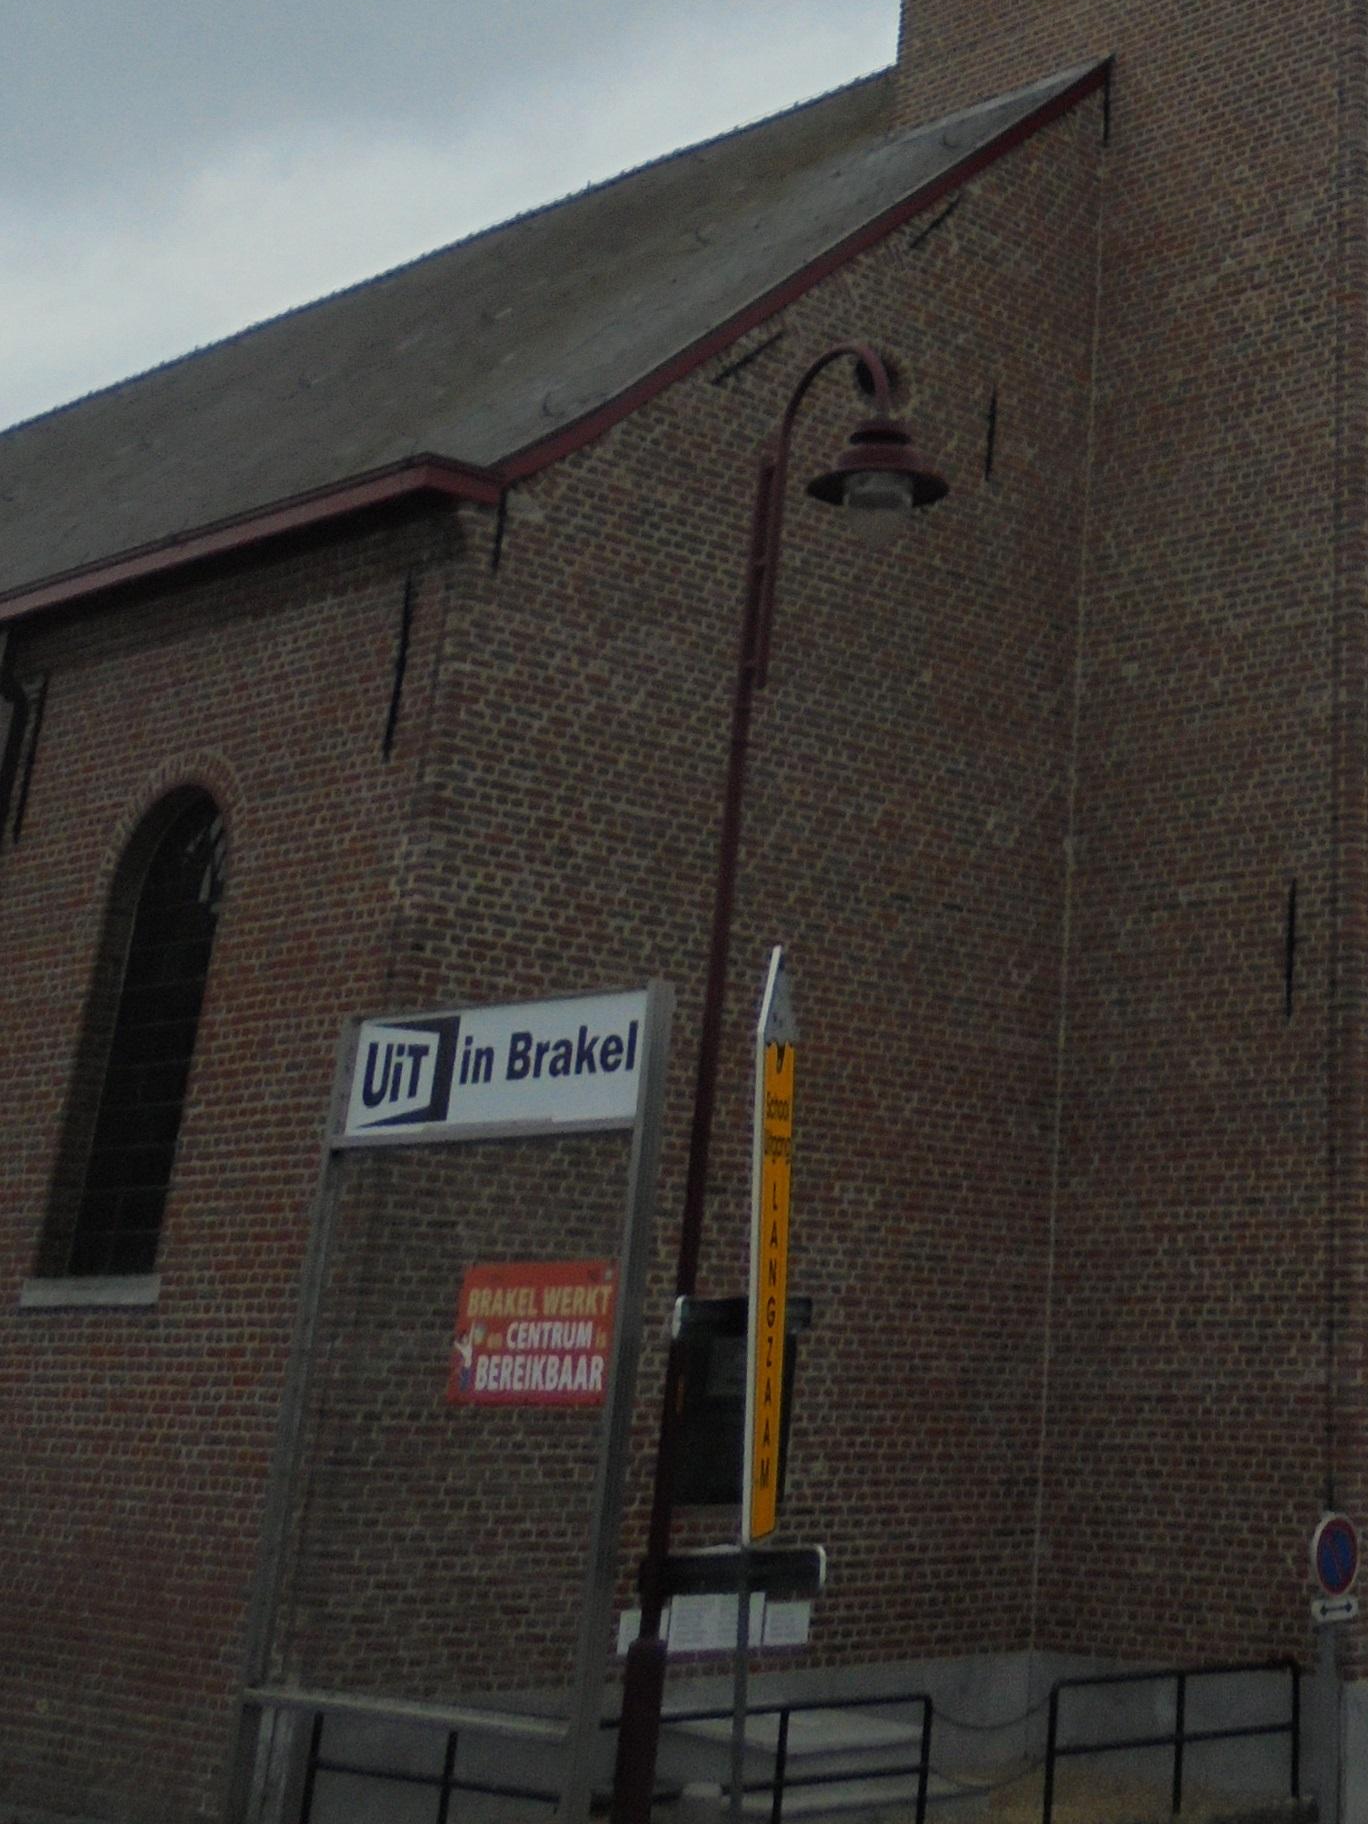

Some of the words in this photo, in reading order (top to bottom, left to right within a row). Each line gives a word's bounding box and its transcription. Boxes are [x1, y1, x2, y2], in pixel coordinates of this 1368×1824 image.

[363, 1042, 430, 1107] UiT
[460, 1036, 495, 1084] in
[506, 1020, 639, 1080] Brakel
[467, 1287, 538, 1318] BRAKEL
[543, 1284, 613, 1316] WERKT
[506, 1321, 593, 1351] CENTRUM
[760, 1182, 778, 1488] LANGZAAM
[475, 1355, 605, 1392] BEREIKBAAR
